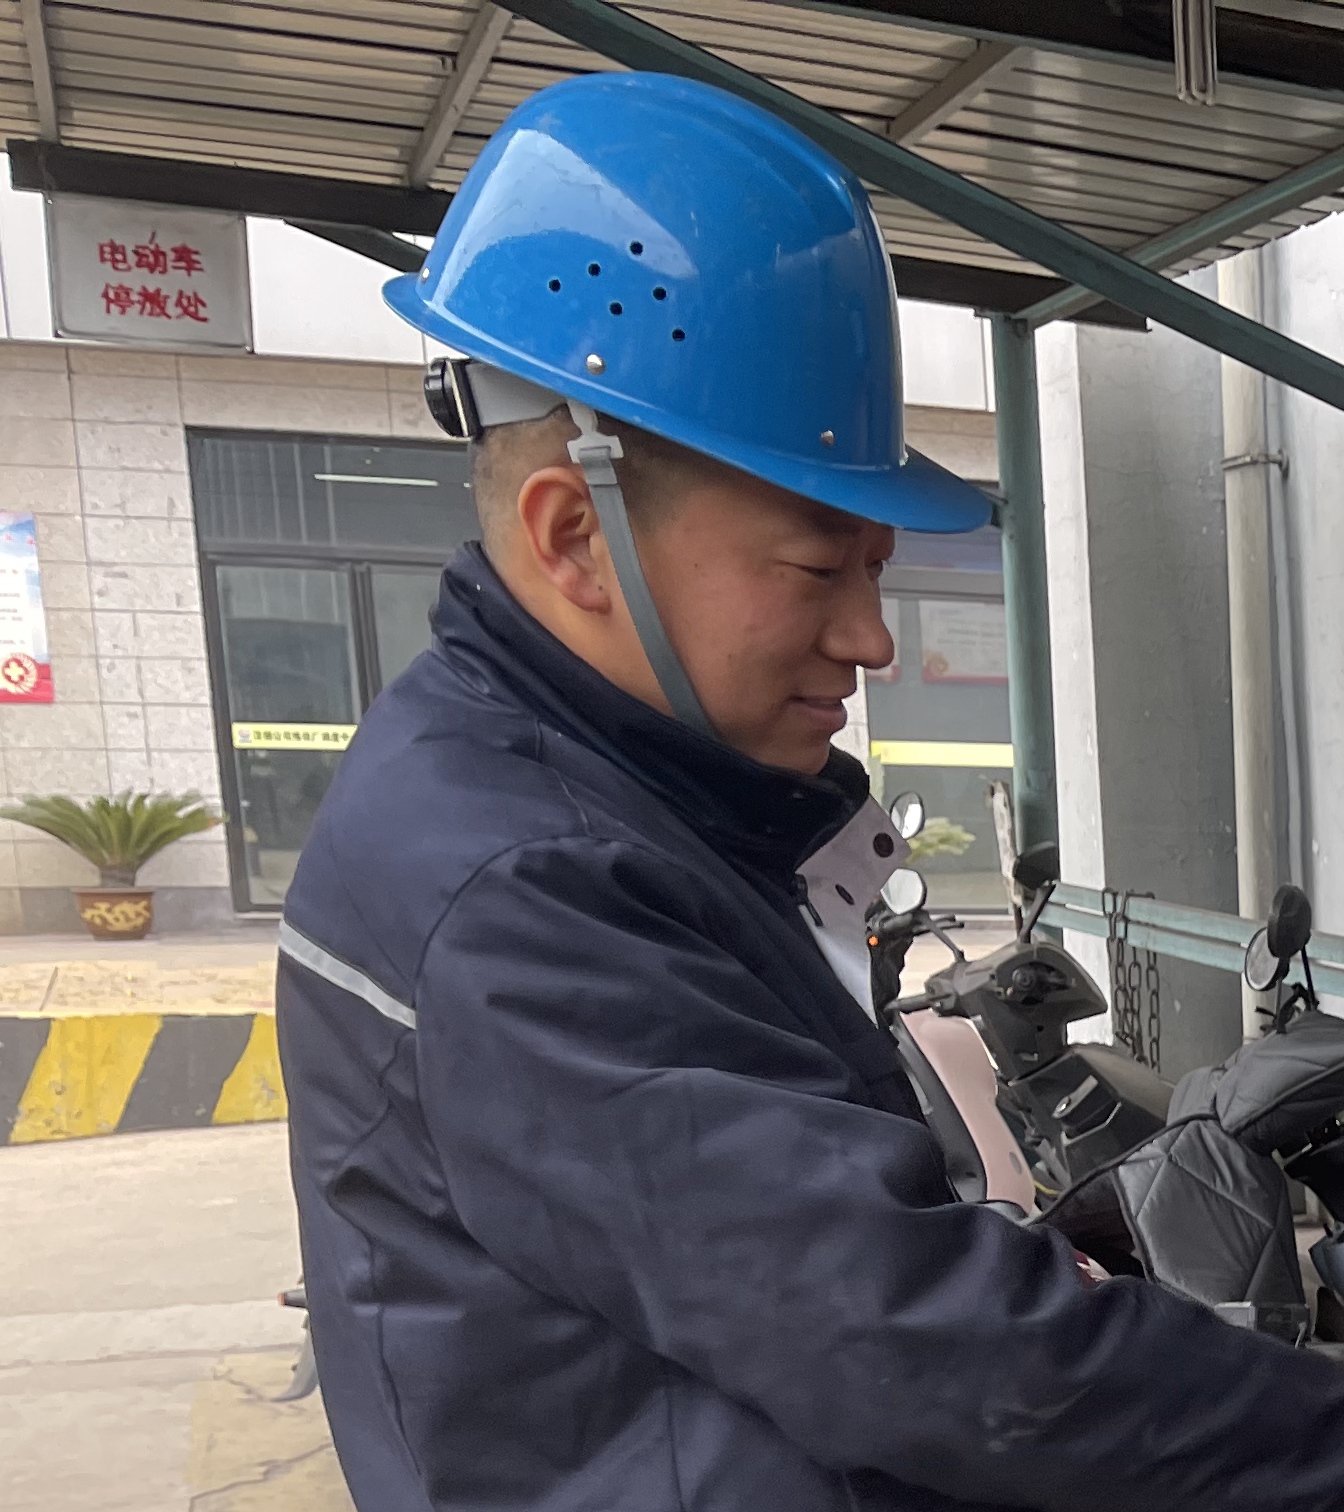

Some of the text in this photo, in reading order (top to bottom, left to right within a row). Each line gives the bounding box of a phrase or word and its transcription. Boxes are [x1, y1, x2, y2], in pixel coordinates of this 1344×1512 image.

[97, 238, 205, 278] 电动车
[101, 283, 210, 324] 停放处
